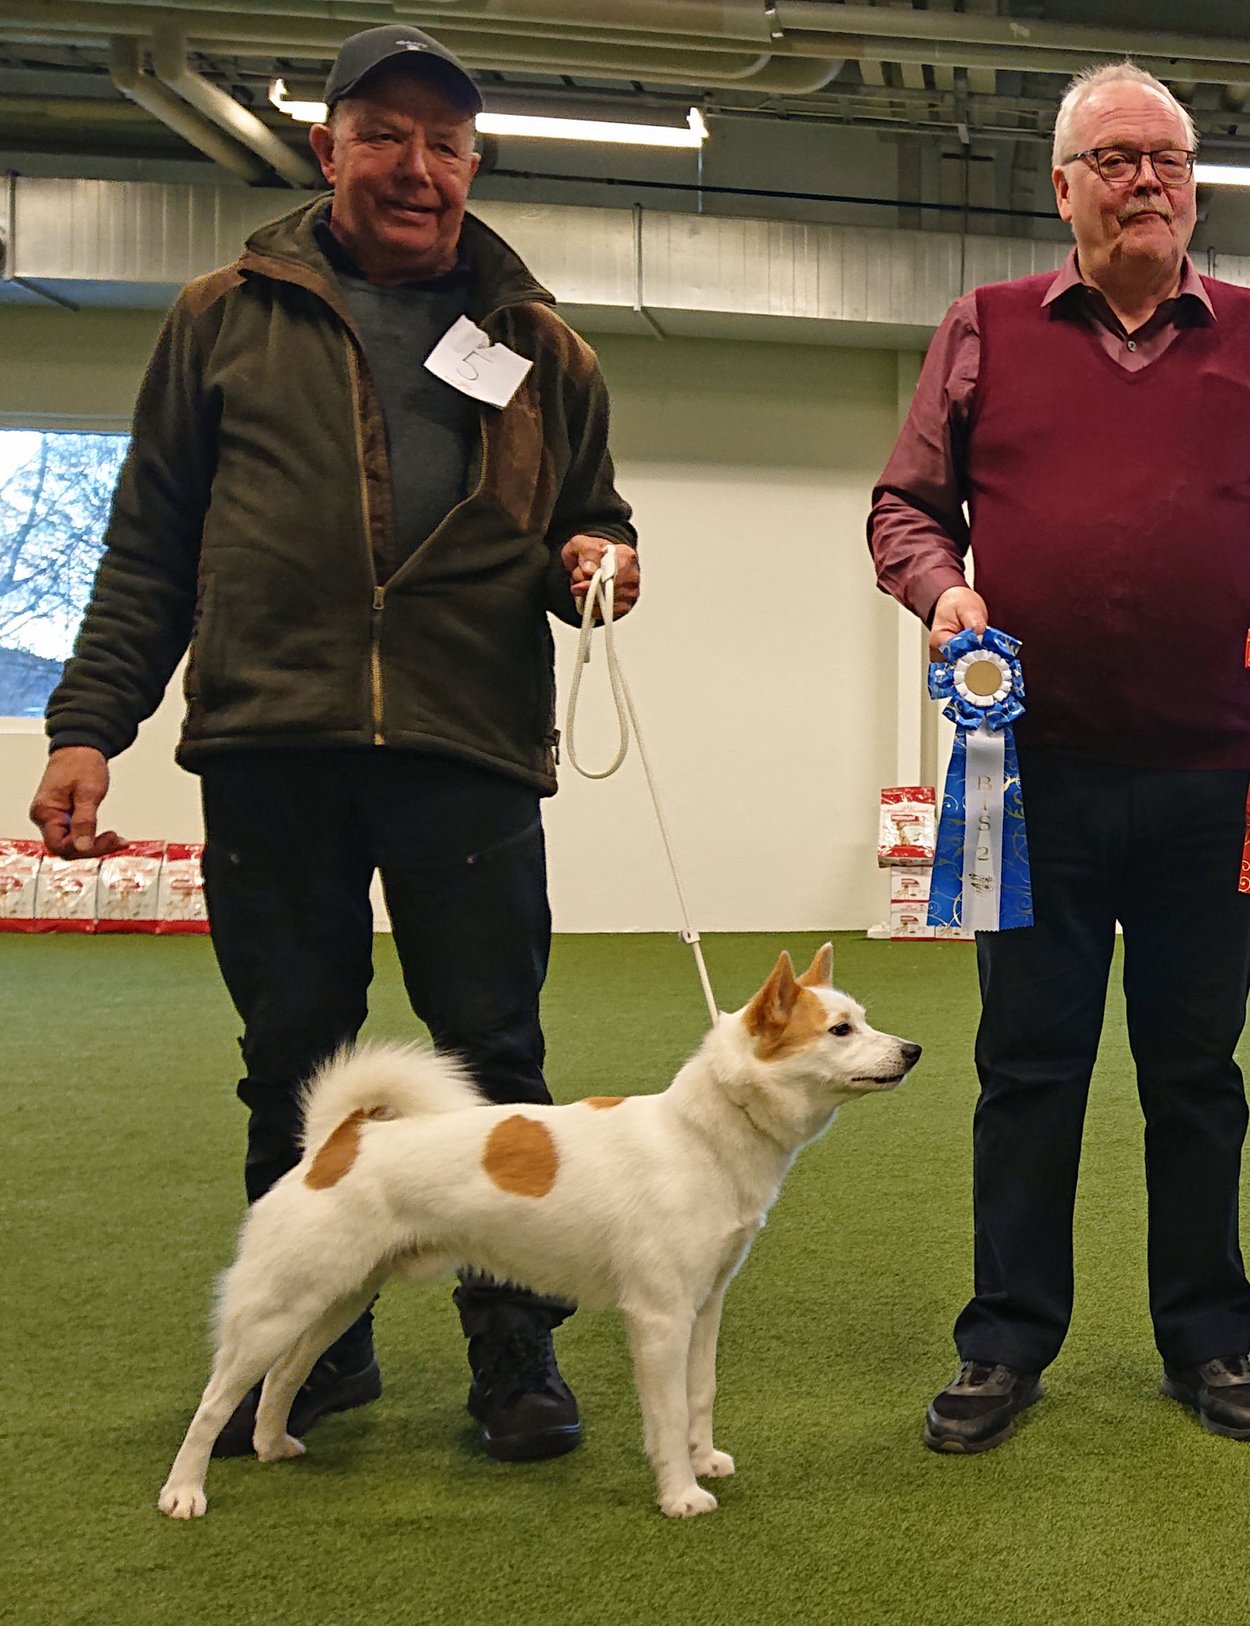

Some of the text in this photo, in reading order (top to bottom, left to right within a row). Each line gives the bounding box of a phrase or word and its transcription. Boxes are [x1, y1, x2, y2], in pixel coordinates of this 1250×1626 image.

[455, 350, 493, 381] 5
[976, 776, 993, 861] BIS 2
